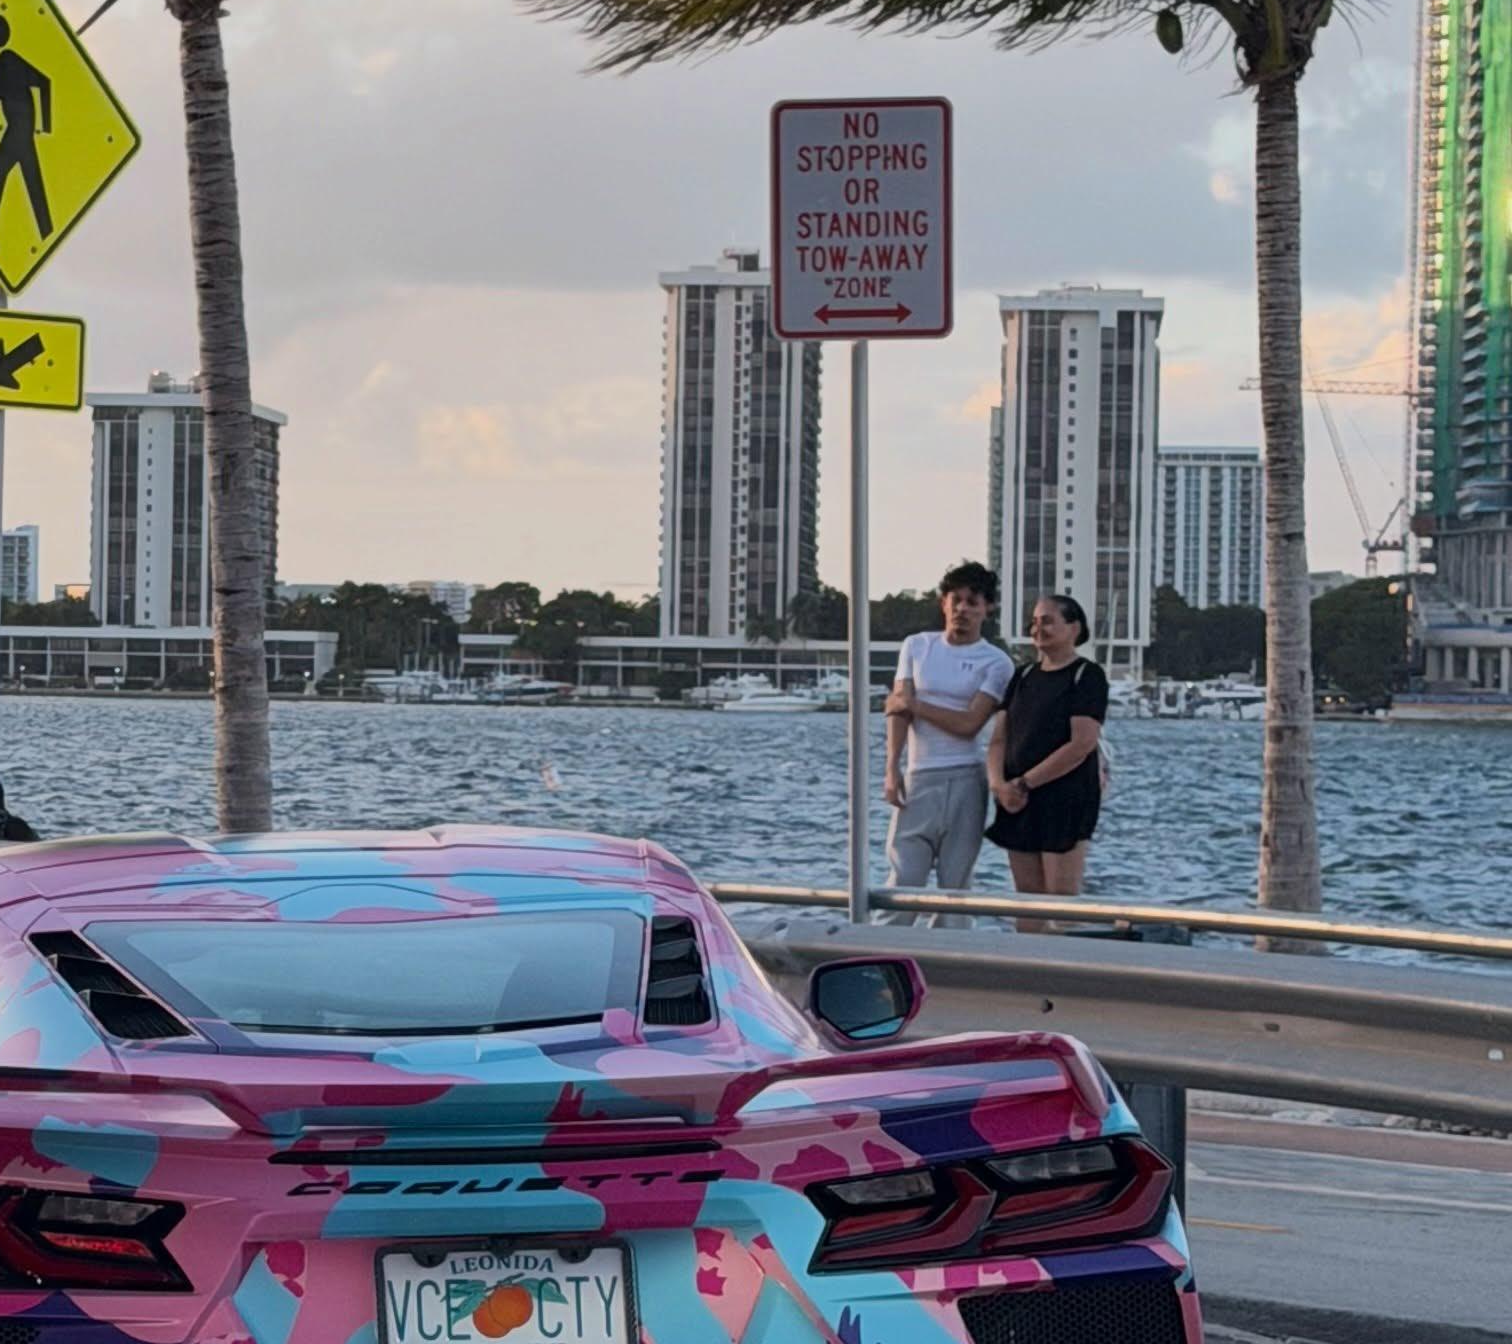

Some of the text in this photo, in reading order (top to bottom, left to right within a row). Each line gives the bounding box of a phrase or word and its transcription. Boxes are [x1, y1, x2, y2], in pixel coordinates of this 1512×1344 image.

[843, 112, 880, 139] NO
[796, 143, 928, 173] STOPPING
[844, 178, 880, 205] OR
[796, 210, 929, 240] STANDING
[796, 243, 929, 273] TOW-AWAY
[833, 277, 892, 299] ZONE
[287, 1169, 727, 1197] COQUETTE
[449, 1254, 555, 1275] LEONIDA
[387, 1275, 619, 1342] VCE CTY
